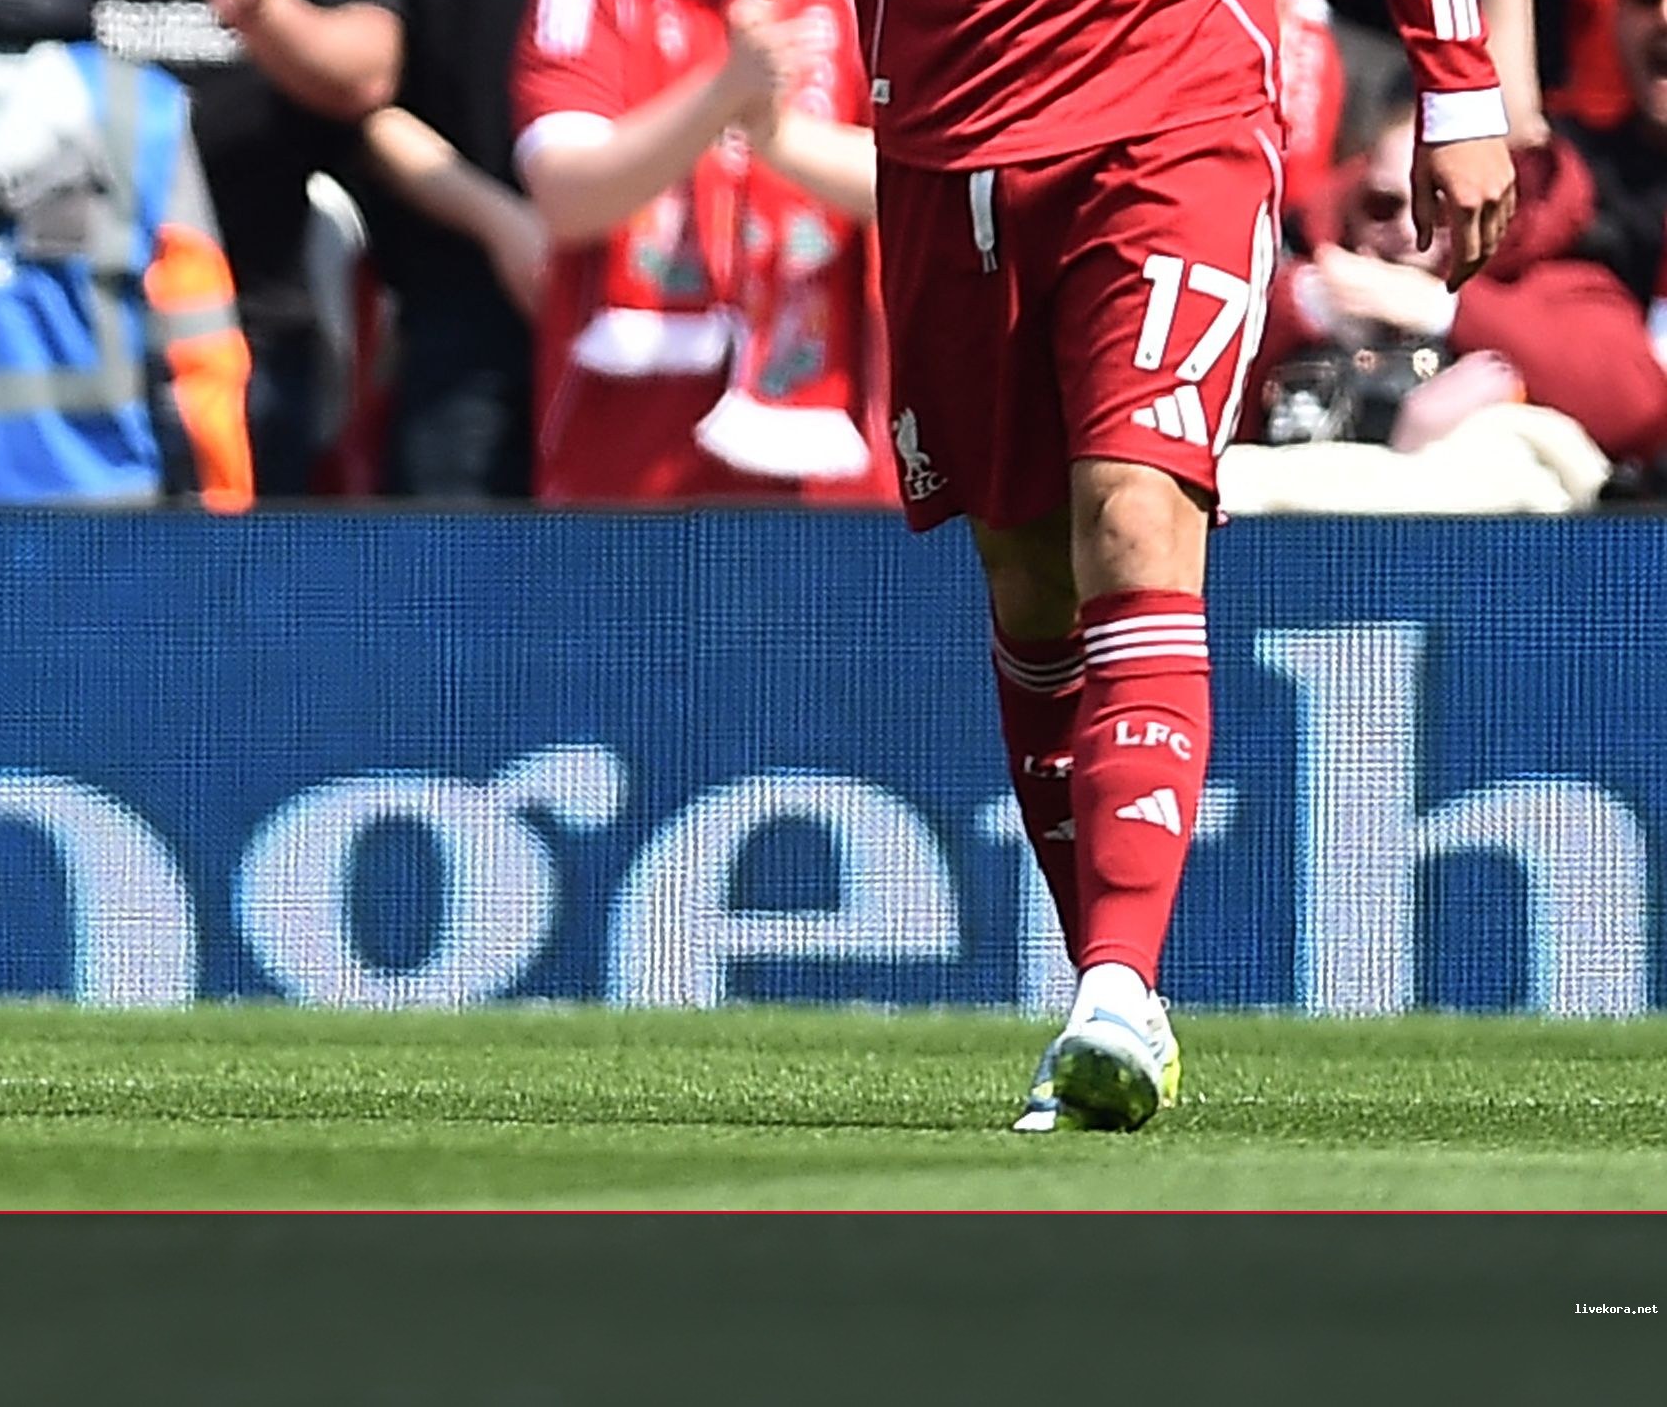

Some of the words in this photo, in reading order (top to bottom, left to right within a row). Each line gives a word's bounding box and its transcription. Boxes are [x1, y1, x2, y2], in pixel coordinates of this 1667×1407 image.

[1134, 254, 1251, 381] 17
[1116, 720, 1191, 761] LFC
[1023, 754, 1074, 778] LF
